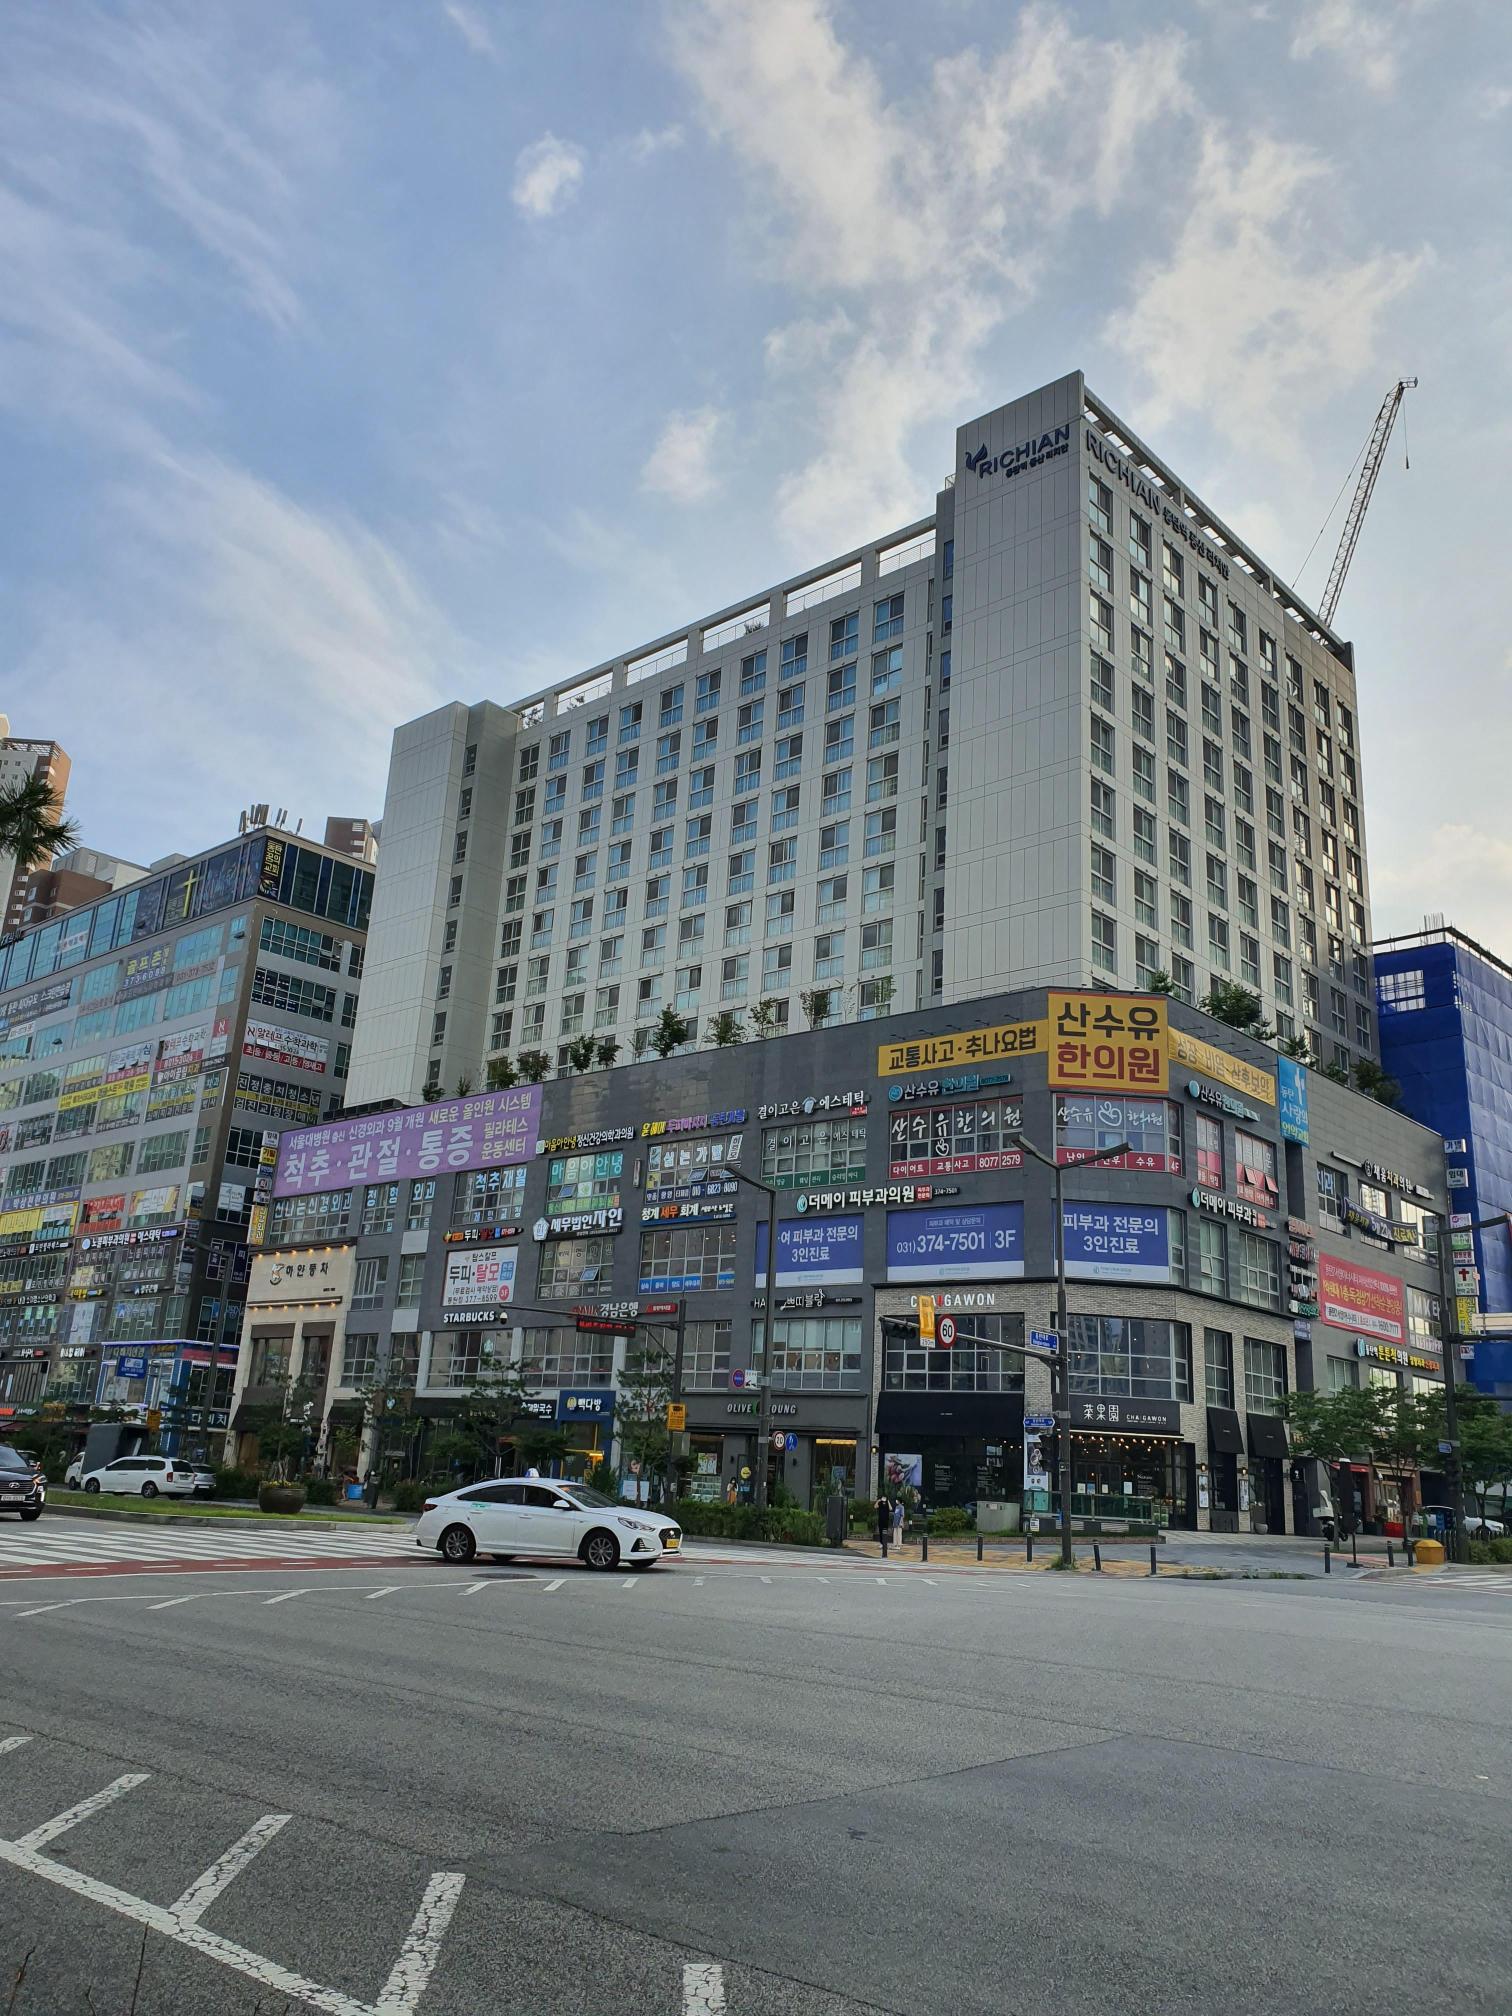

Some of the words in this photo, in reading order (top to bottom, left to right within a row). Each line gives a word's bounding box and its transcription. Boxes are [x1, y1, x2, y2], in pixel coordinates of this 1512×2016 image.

[980, 424, 1070, 479] RICHIAN
[1086, 429, 1160, 516] RICHIAN
[1057, 1003, 1161, 1041] 산수유
[1057, 1042, 1160, 1084] 한의원
[904, 1080, 940, 1100] 산수유
[819, 1091, 864, 1110] 에스테틱
[288, 1128, 331, 1150] 서울대병원
[349, 1120, 385, 1140] 신경외과
[404, 1112, 425, 1129] 개원
[429, 1106, 459, 1126] 새로운
[462, 1100, 495, 1120] 올인원
[498, 1092, 532, 1114] 시스템
[483, 1118, 529, 1138] 필라테스
[481, 1137, 526, 1160] 운동센터
[1001, 1154, 1021, 1167] 2579
[1170, 1160, 1180, 1172] 4F
[809, 1191, 846, 1211] 더메이
[848, 1185, 915, 1208] 피부과의원
[1200, 1190, 1226, 1216] 더메이
[641, 1206, 660, 1220] 청계
[680, 1203, 700, 1217] 회계
[550, 1214, 592, 1233] 세무법인
[1063, 1213, 1109, 1233] 피부과
[1113, 1216, 1159, 1236] 전문의
[792, 1227, 825, 1245] 피부과
[826, 1224, 859, 1243] 전문의
[896, 1239, 916, 1254] 031)
[917, 1231, 985, 1253] 374-7501
[994, 1229, 1016, 1249] 3F
[1083, 1235, 1140, 1254] 3인진료
[791, 1246, 830, 1263] 3인진료
[599, 1301, 639, 1318] 경남은행
[944, 1293, 995, 1307] GAWON
[443, 1310, 495, 1323] STARBUCKS
[942, 1323, 953, 1338] 60
[577, 1398, 602, 1412] 빽다방
[727, 1403, 753, 1413] OLIVE
[770, 1404, 797, 1414] OUNG
[1142, 1414, 1167, 1422] GAWON
